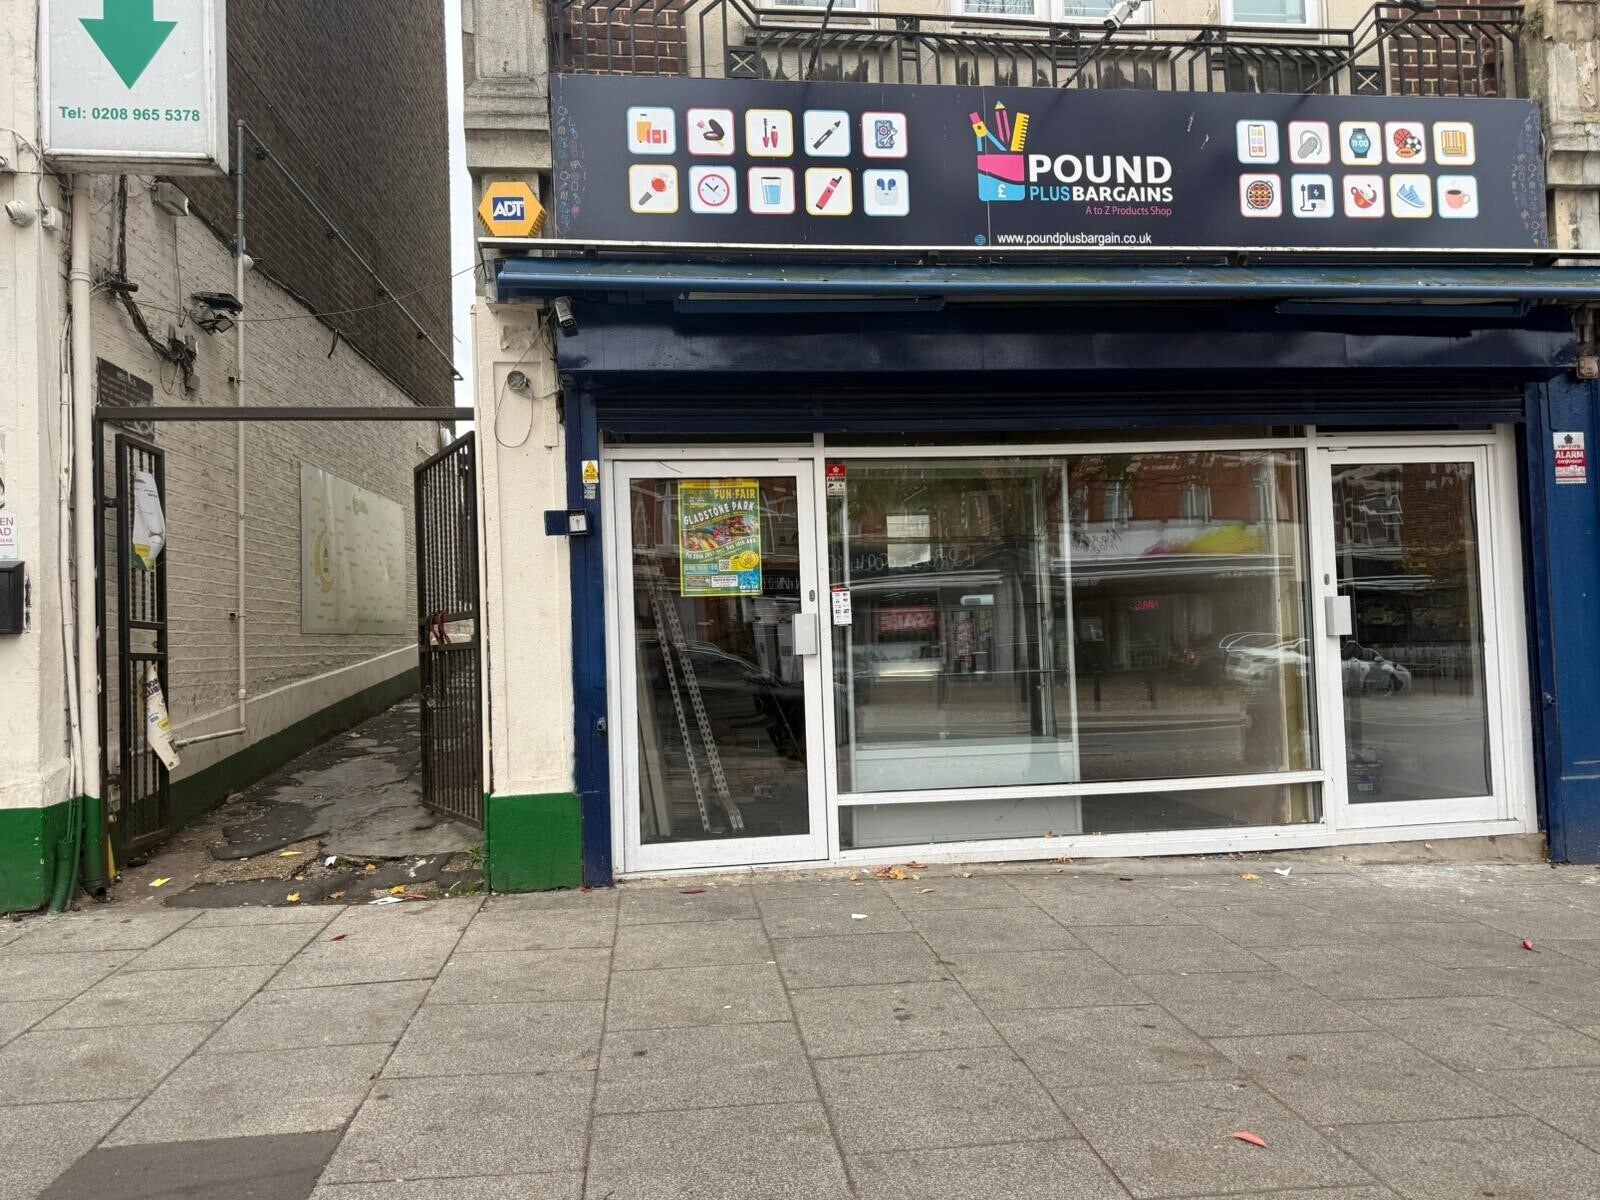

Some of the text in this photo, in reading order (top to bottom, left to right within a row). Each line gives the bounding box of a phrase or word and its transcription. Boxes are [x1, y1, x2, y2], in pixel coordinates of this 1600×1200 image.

[59, 106, 200, 122] Tel: 0208 965 5378
[1028, 154, 1172, 184] POUND
[493, 201, 524, 217] ADT
[1086, 205, 1172, 217] A to Z Products Shop
[997, 232, 1152, 246] www.poundplusbargain.co.uk
[1555, 450, 1584, 459] ALARM
[683, 501, 755, 525] GLADSTONE PARK
